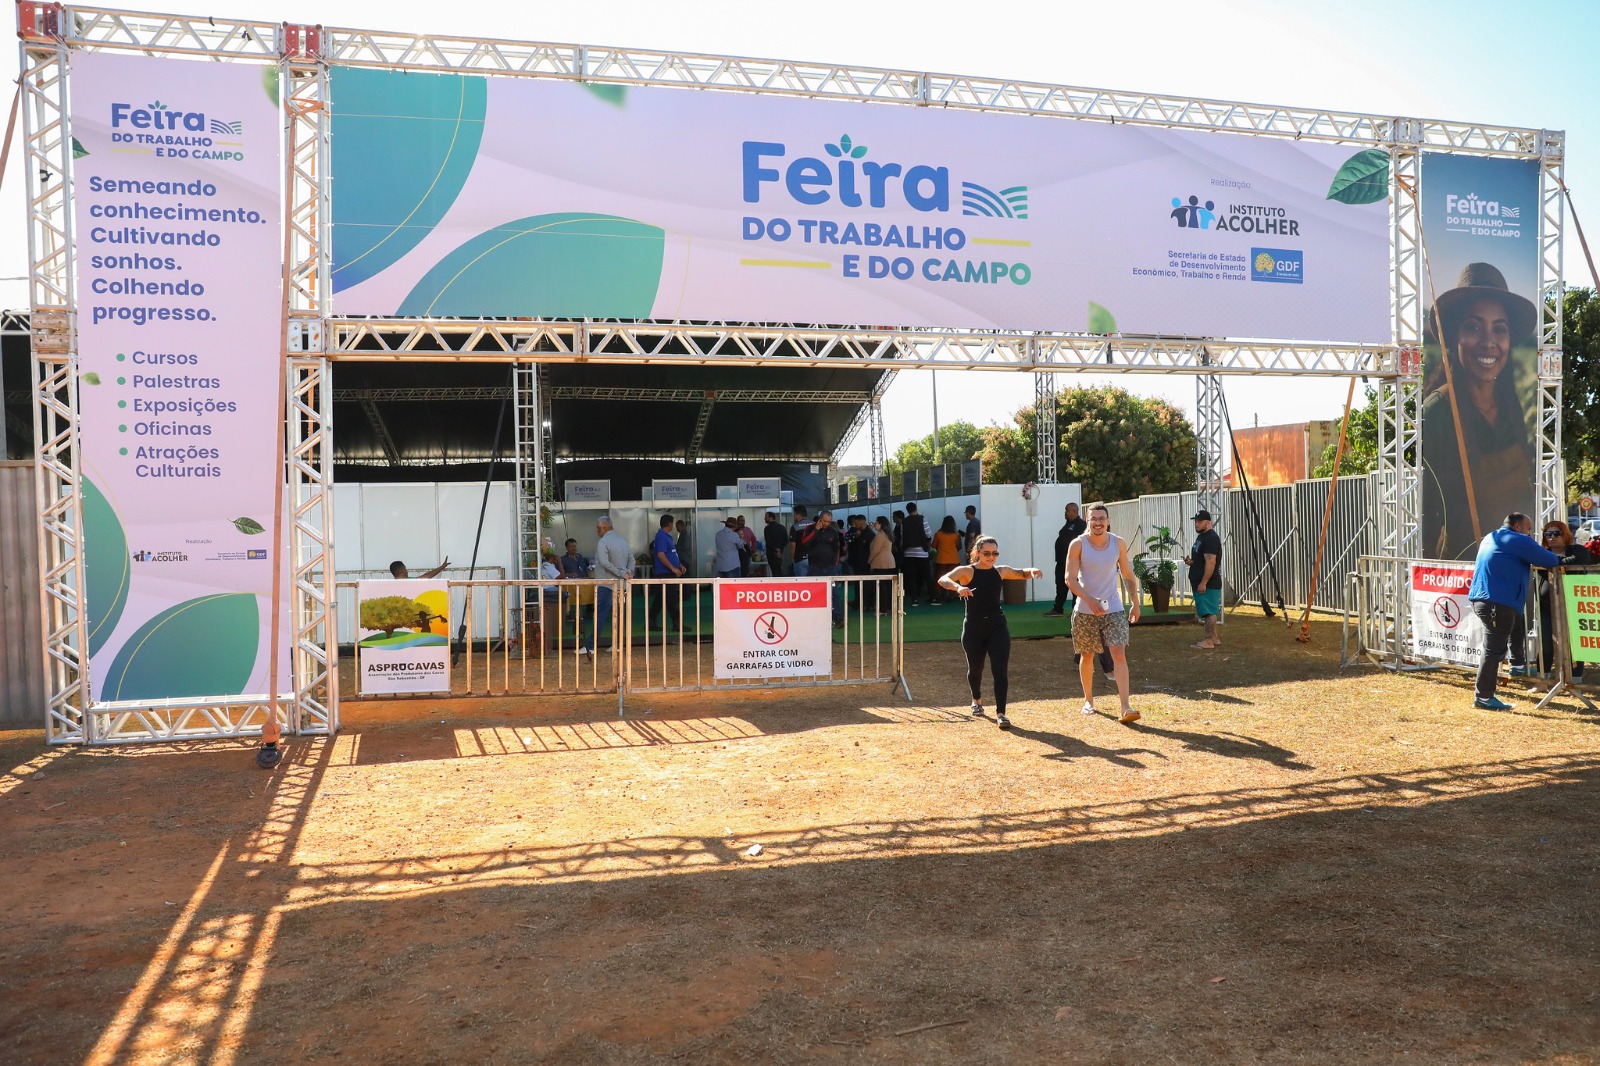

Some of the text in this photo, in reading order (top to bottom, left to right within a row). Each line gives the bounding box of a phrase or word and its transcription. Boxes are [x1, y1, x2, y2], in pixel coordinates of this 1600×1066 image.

[111, 101, 205, 132] Feira
[112, 133, 213, 147] DO TRABALHO
[156, 147, 244, 162] E DO CAMPO
[742, 136, 949, 212] Feira
[89, 176, 217, 196] Semeando
[1210, 178, 1251, 190] Realização
[1229, 204, 1286, 218] INSTITUTO
[1446, 193, 1499, 216] Feira
[89, 202, 267, 224] conhecimento.
[1215, 215, 1300, 236] ACOLHER
[1446, 216, 1503, 227] DO TRABALHO
[90, 226, 221, 247] Cultivando
[742, 216, 966, 251] DO TRABALHO
[1471, 227, 1520, 238] E DO CAMPO
[91, 253, 182, 271] sonhos.
[1168, 250, 1246, 262] Secretaria de Estado
[843, 254, 1031, 286] E DO CAMPO
[1169, 260, 1246, 272] de Desenvolvimento
[1276, 260, 1300, 271] GDF
[1132, 267, 1179, 279] Econômico,
[1180, 270, 1214, 279] Trabalho
[1222, 272, 1246, 281] Renda
[91, 277, 205, 296] Colhendo
[92, 305, 217, 326] progresso.
[132, 350, 198, 365] Cursos
[133, 374, 220, 389] Palestras
[133, 397, 237, 416] Exposições
[134, 421, 212, 436] Oficinas
[135, 445, 219, 463] Atrações
[135, 463, 221, 478] Culturais
[736, 589, 812, 603] PROIBIDO
[1454, 634, 1469, 643] COM
[743, 649, 798, 658] ENTRAR COM
[1451, 644, 1460, 652] DE
[368, 661, 445, 672] ASPROCAVAS
[726, 660, 814, 670] GARRAFAS DE VIDRO
